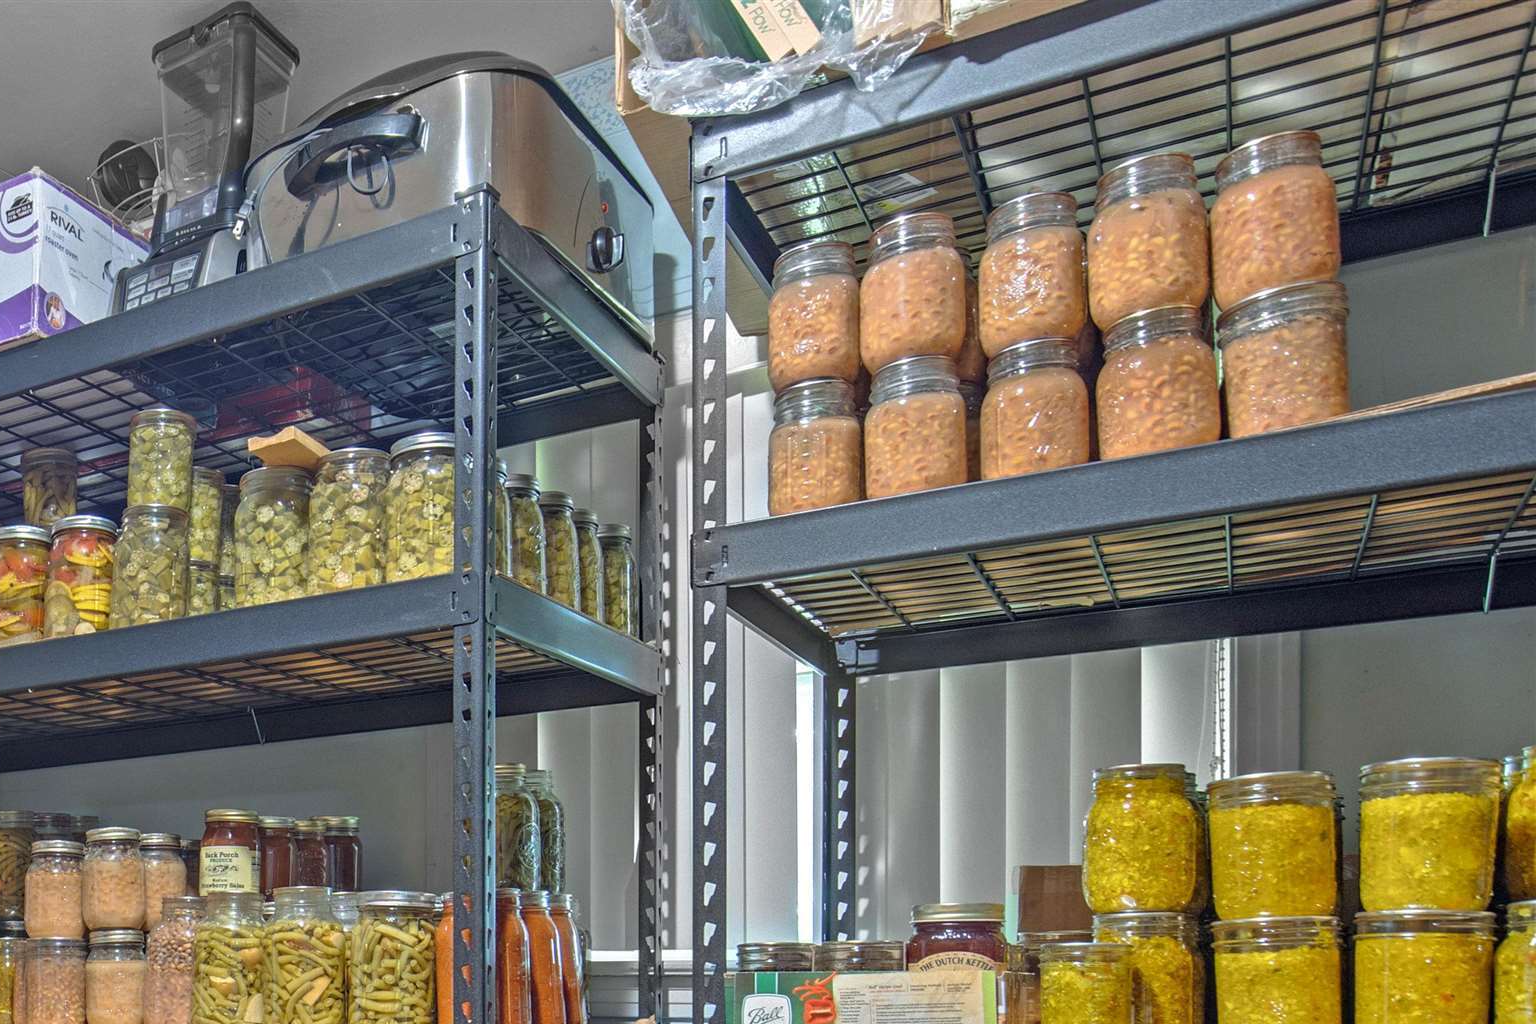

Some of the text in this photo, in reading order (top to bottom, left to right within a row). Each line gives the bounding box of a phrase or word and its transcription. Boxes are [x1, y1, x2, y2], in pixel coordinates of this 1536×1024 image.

[50, 211, 84, 242] RIVAL
[935, 956, 964, 967] DUTCH
[964, 958, 995, 971] KETTLE
